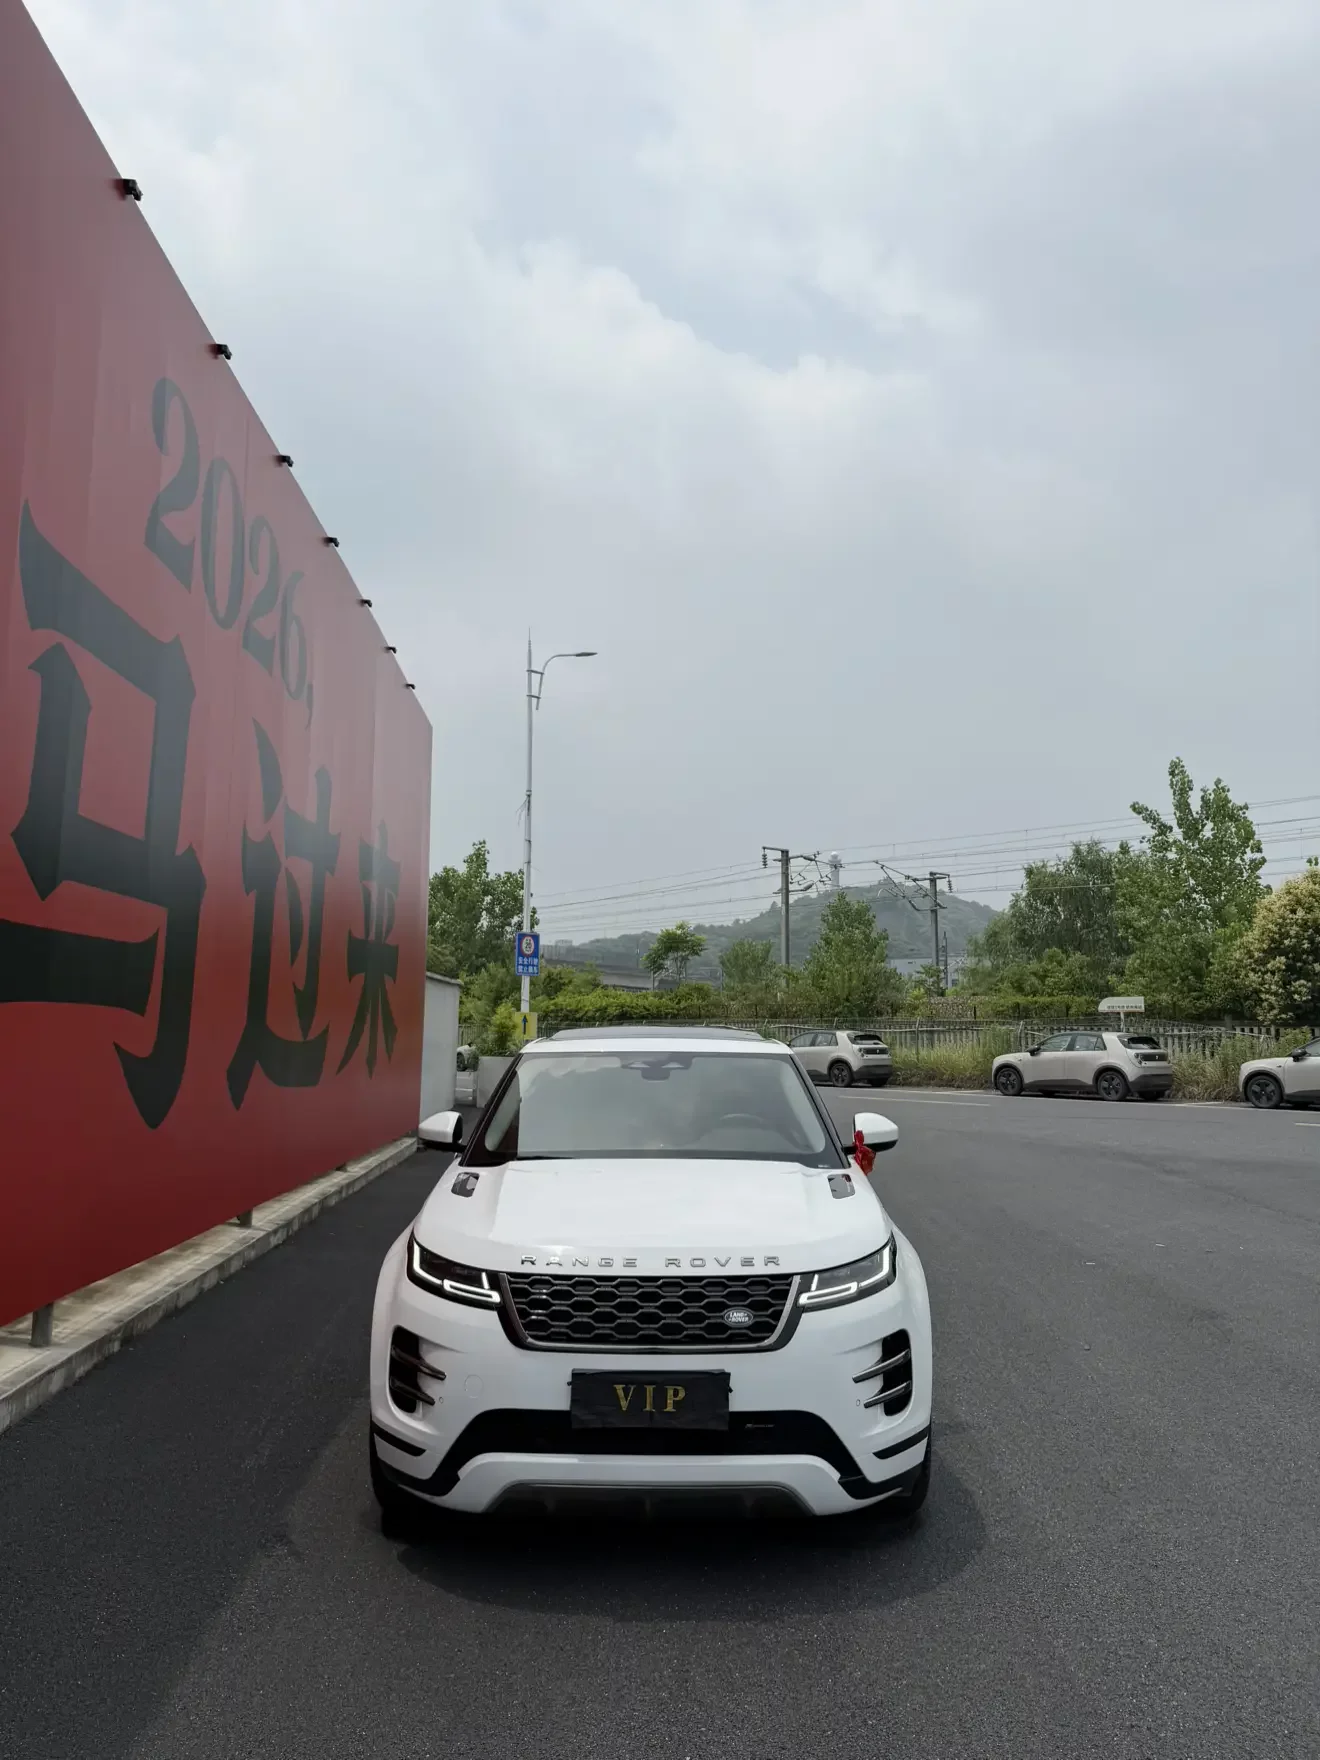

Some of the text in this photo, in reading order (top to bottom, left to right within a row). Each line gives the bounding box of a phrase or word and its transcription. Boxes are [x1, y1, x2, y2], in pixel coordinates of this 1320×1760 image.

[520, 1255, 780, 1268] RANGE ROVER
[614, 1384, 686, 1412] VIP
